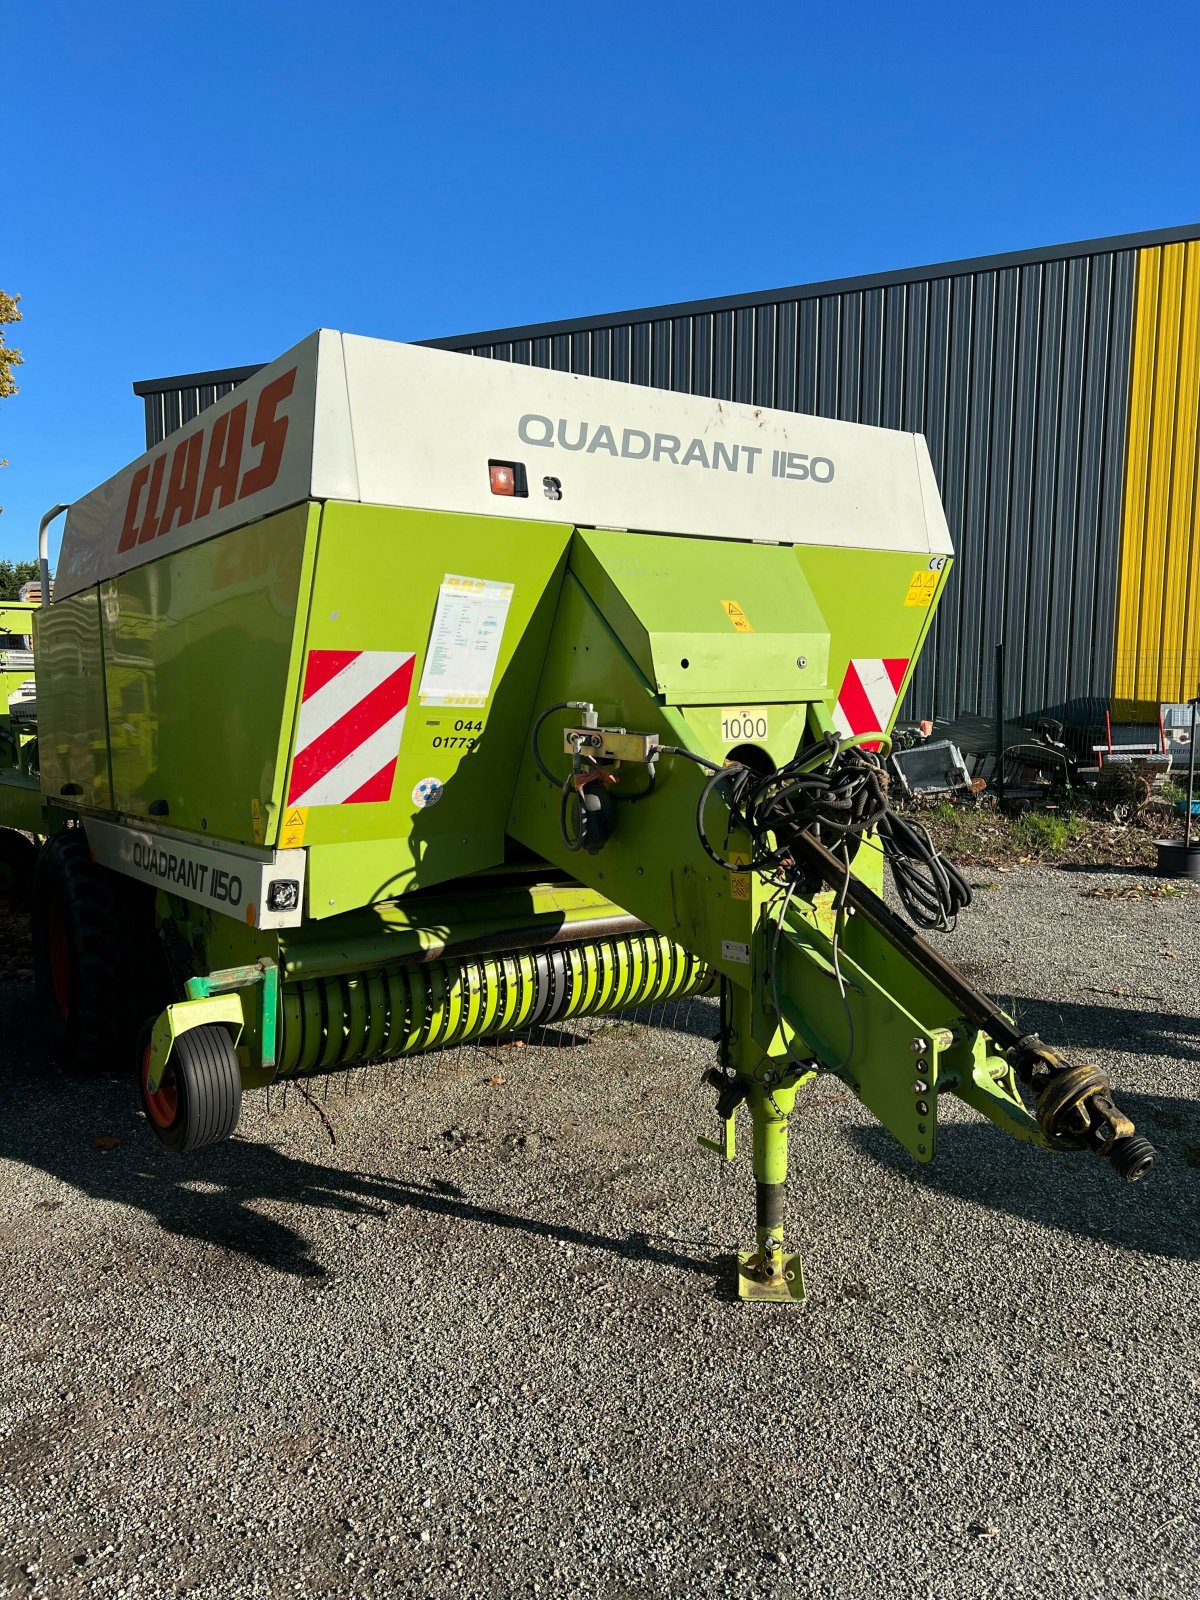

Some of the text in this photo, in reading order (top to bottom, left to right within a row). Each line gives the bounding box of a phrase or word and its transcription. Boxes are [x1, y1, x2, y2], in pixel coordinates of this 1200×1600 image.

[117, 366, 298, 554] CLAAS
[517, 413, 835, 484] QUADRANT 1150
[432, 736, 476, 750] 01773
[454, 720, 483, 732] 044
[721, 718, 767, 739] 1000
[133, 842, 243, 906] QUADRANT 1150
